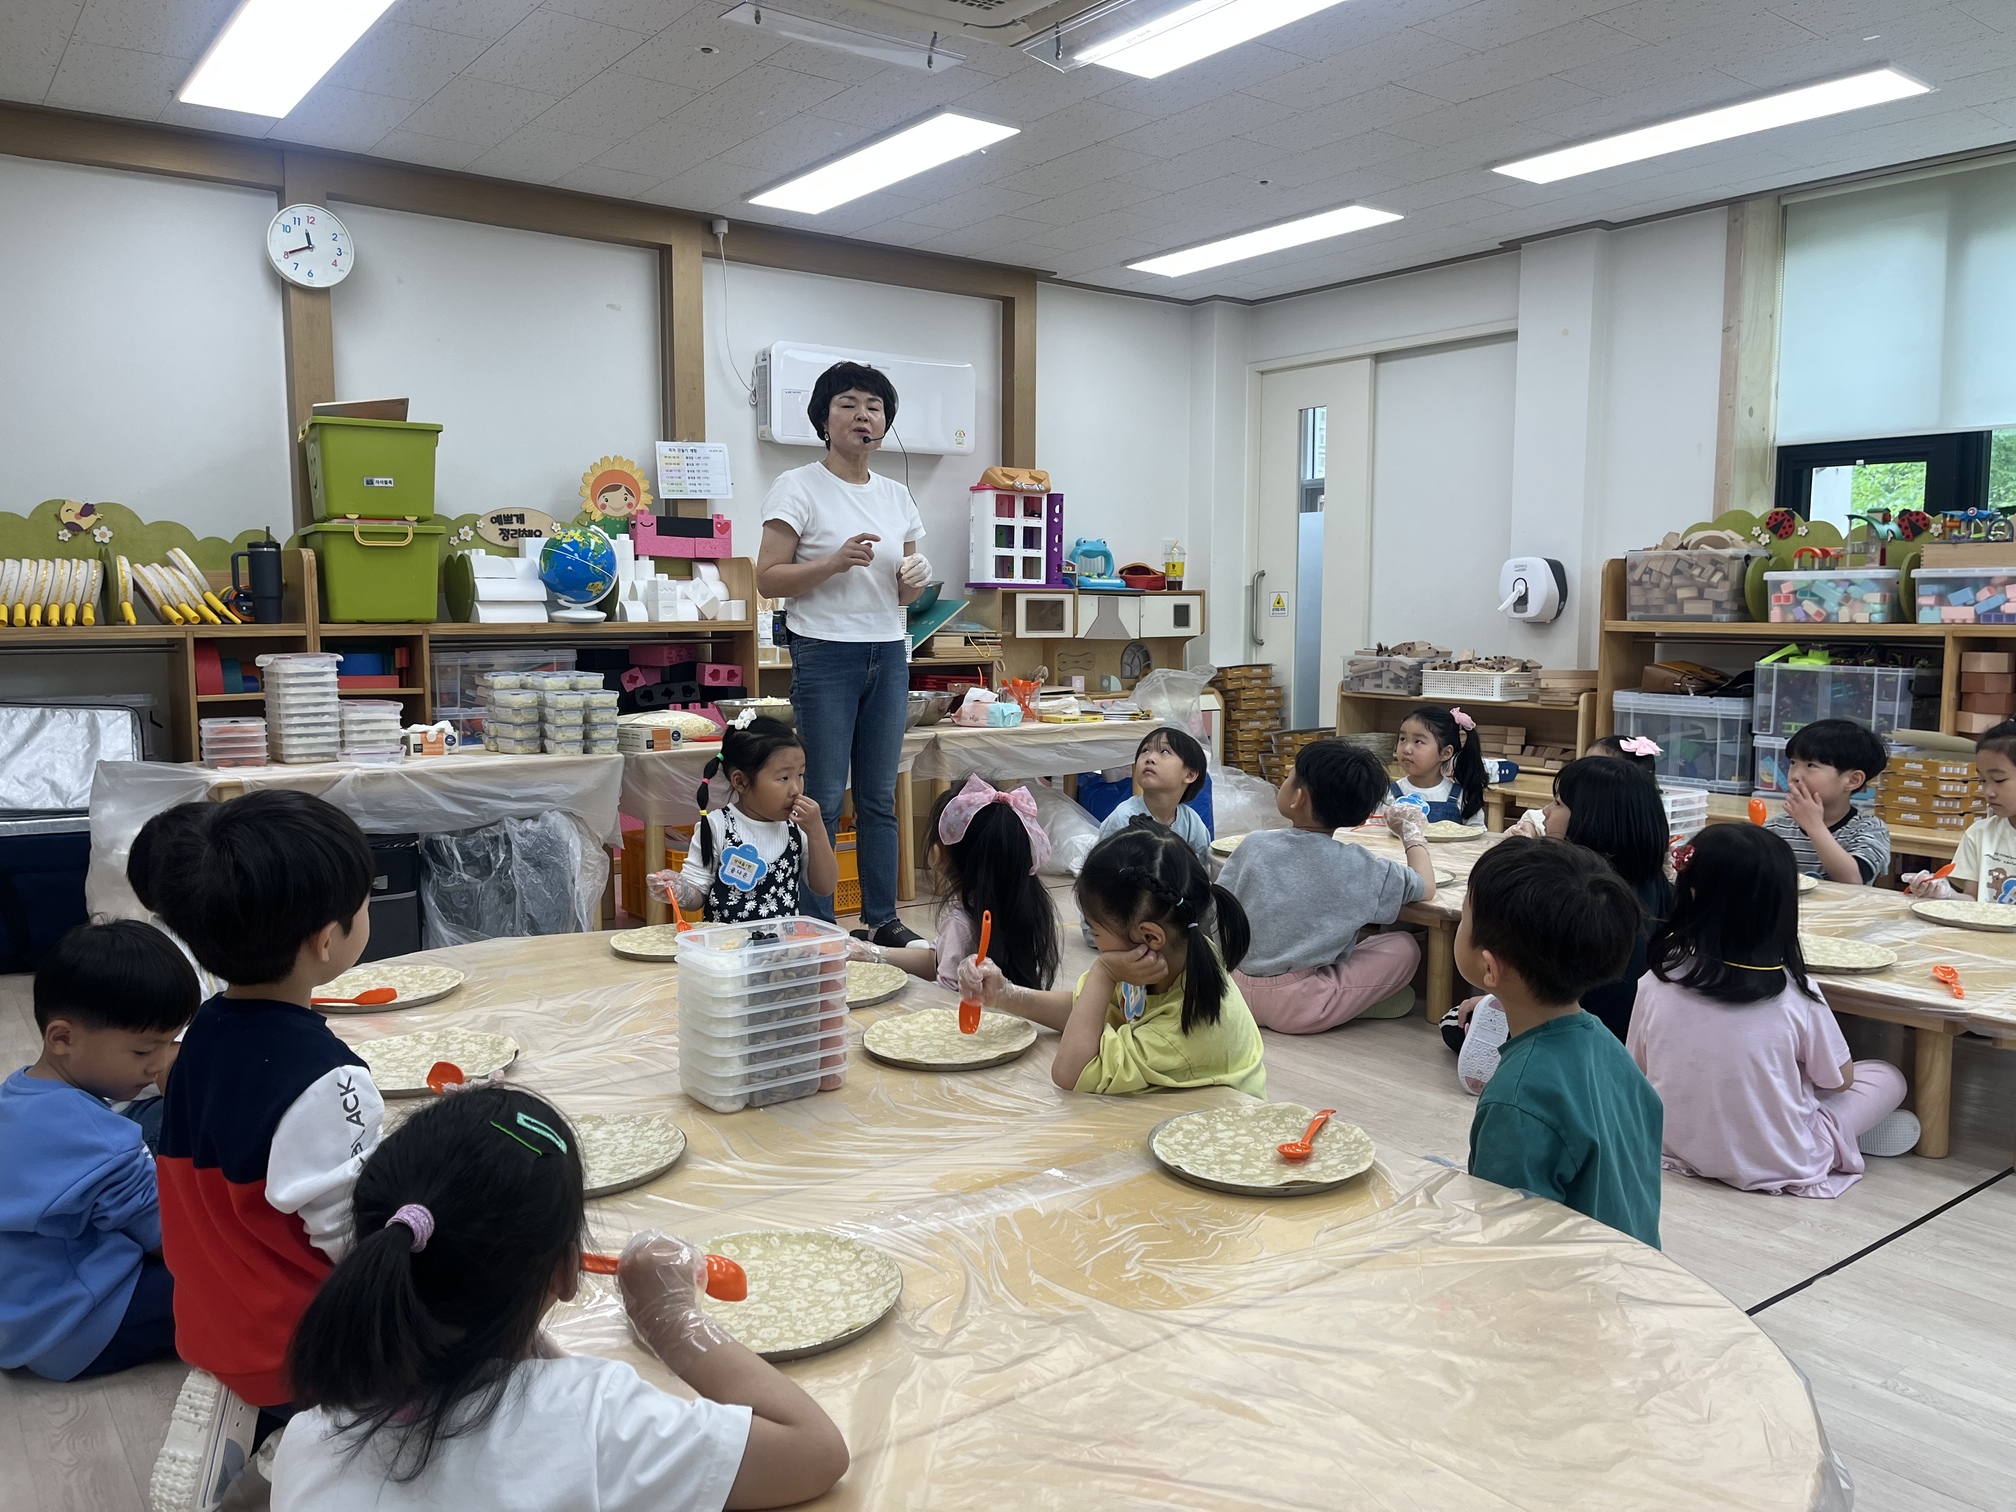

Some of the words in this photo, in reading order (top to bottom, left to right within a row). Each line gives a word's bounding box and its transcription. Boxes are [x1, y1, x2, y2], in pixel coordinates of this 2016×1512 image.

[293, 216, 301, 226] 11
[306, 215, 316, 225] 12
[282, 224, 292, 233] 10
[331, 233, 338, 242] 2
[283, 251, 290, 260] 8
[336, 247, 343, 256] 3
[293, 262, 300, 271] 7
[331, 259, 338, 267] 4
[307, 269, 314, 278] 6
[490, 513, 525, 526] 예쁘게
